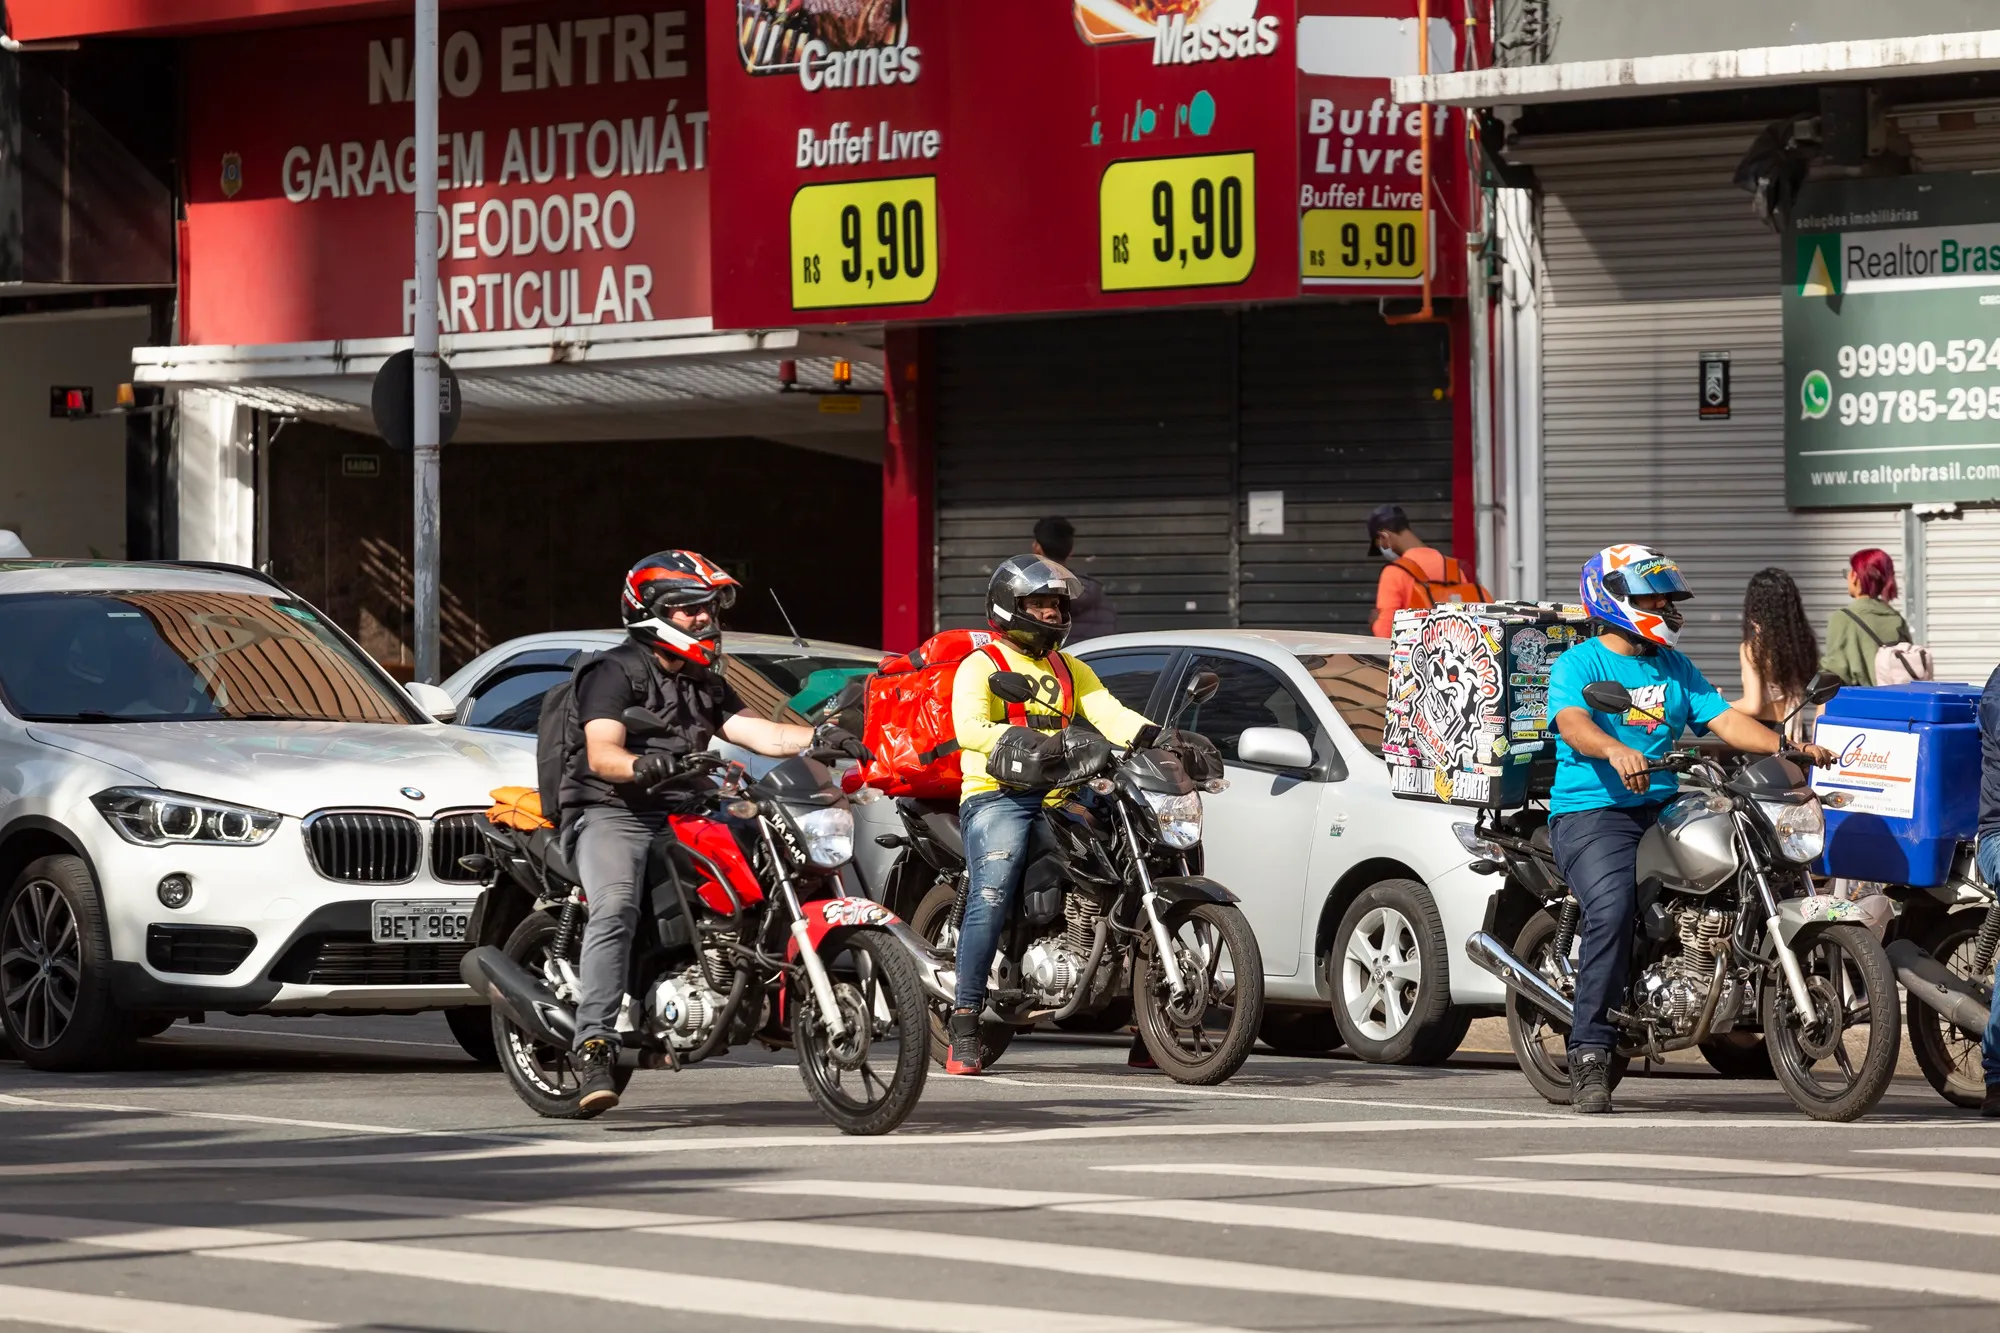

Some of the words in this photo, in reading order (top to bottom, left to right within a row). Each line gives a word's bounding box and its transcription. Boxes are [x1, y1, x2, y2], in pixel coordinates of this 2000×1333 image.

[369, 30, 482, 105] NO
[501, 10, 687, 92] ENTRE
[1152, 13, 1279, 66] Massas
[800, 39, 921, 92] Carnes
[796, 122, 873, 168] Buffet
[878, 121, 941, 161] Livre
[1315, 138, 1424, 176] Livre
[1301, 183, 1366, 208] Buffet
[1371, 185, 1424, 208] Livre
[803, 254, 820, 284] R$
[840, 199, 925, 288] 9,90
[1112, 233, 1129, 265] R$
[1152, 176, 1242, 270] 9,90
[1309, 250, 1325, 267] R$
[1341, 223, 1416, 270] 9,90
[1838, 337, 2000, 379] 99990-524
[1811, 462, 2000, 486] www.realtorbrasil.com
[1471, 645, 1497, 696] LOKO
